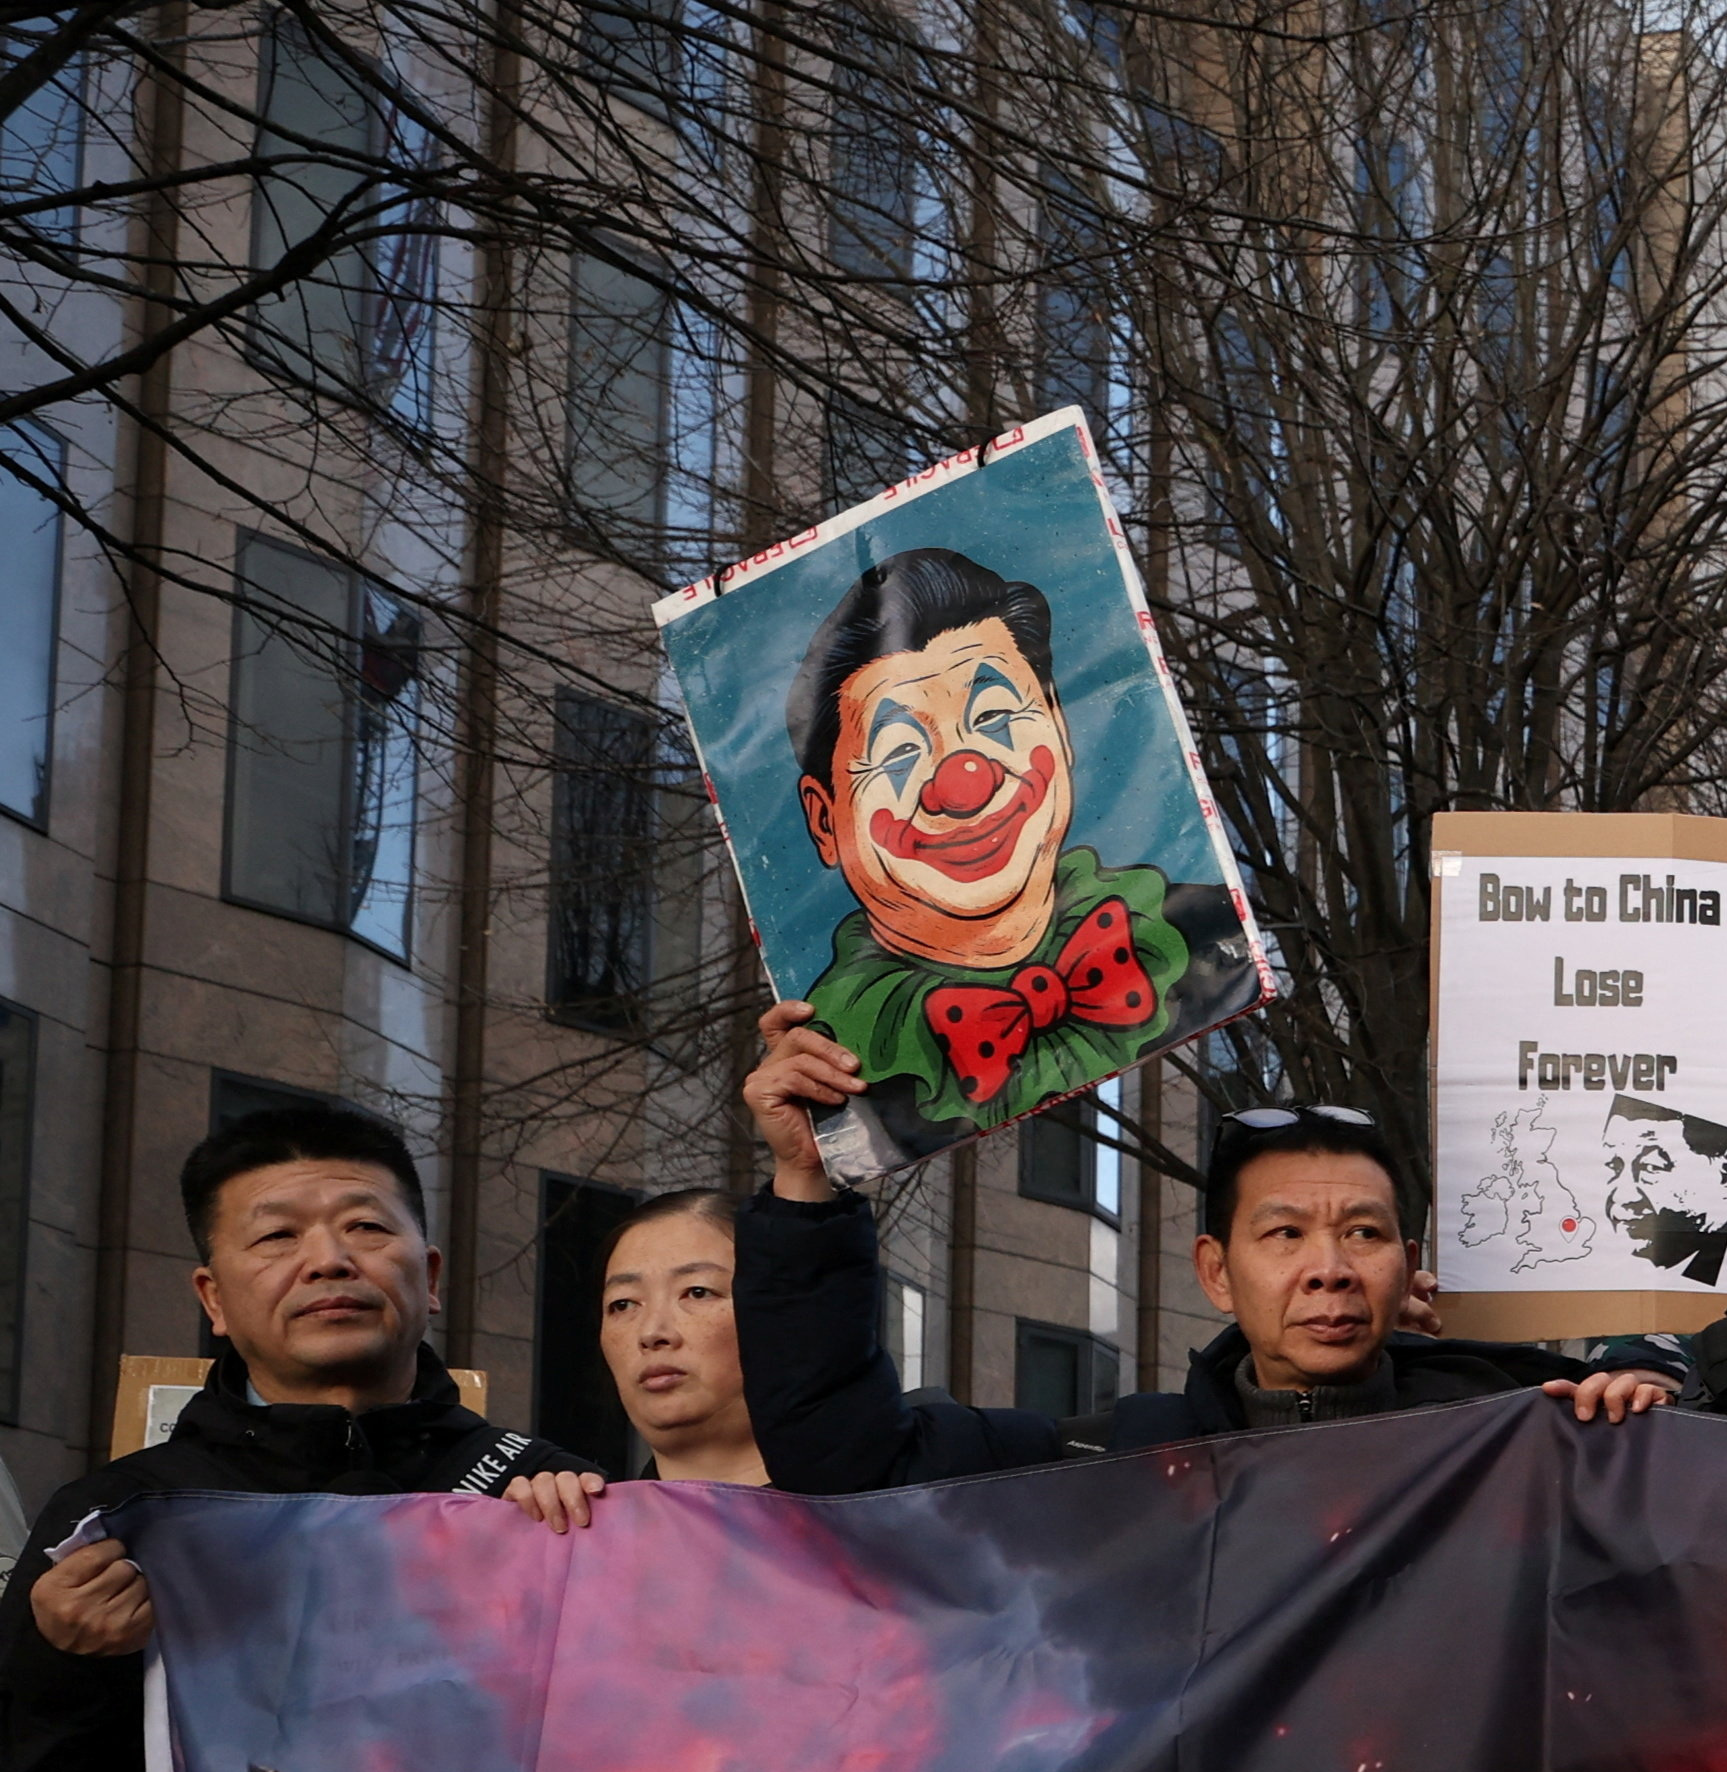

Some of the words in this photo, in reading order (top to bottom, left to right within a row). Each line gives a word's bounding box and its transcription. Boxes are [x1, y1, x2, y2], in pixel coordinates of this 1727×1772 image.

[1479, 873, 1551, 922] Bow
[1564, 878, 1607, 922] to
[1619, 874, 1720, 926] China
[1554, 956, 1643, 1007] Lose
[1518, 1041, 1677, 1092] Forever
[452, 1455, 507, 1494] NIKE
[495, 1433, 532, 1461] AIR
